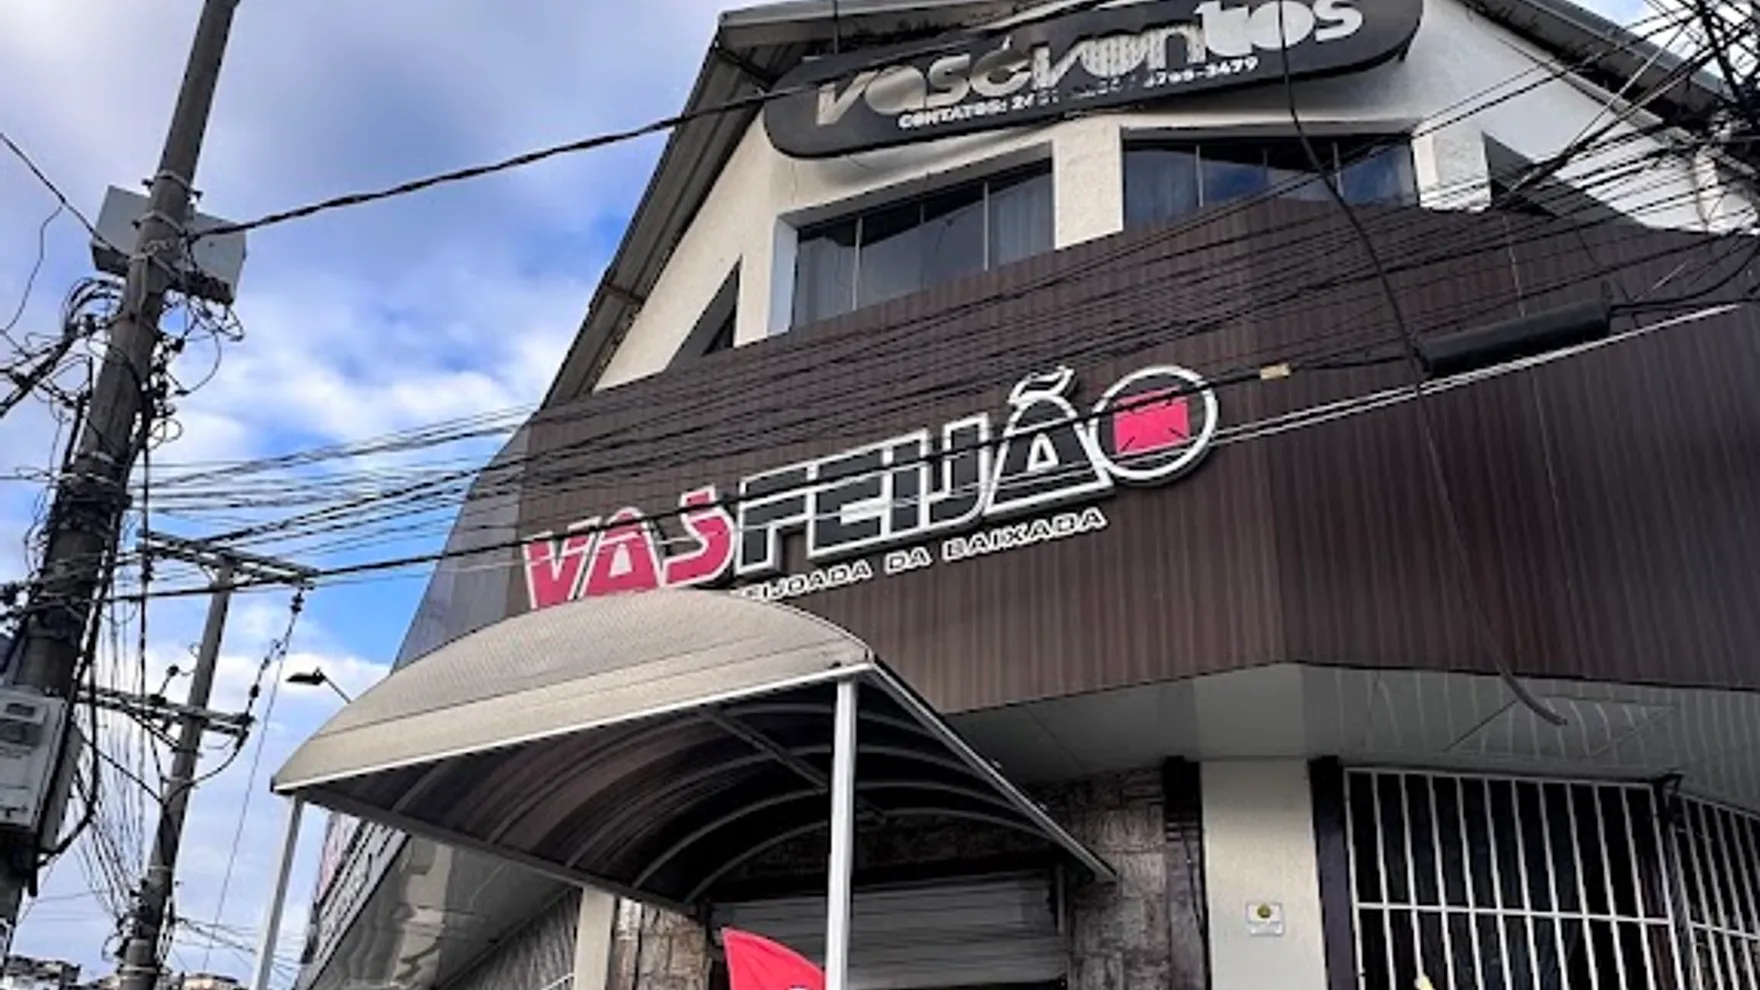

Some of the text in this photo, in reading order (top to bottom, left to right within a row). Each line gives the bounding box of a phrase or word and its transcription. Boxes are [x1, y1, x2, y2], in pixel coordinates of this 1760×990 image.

[732, 507, 1107, 601] EIJOADA DA BAIXADA
